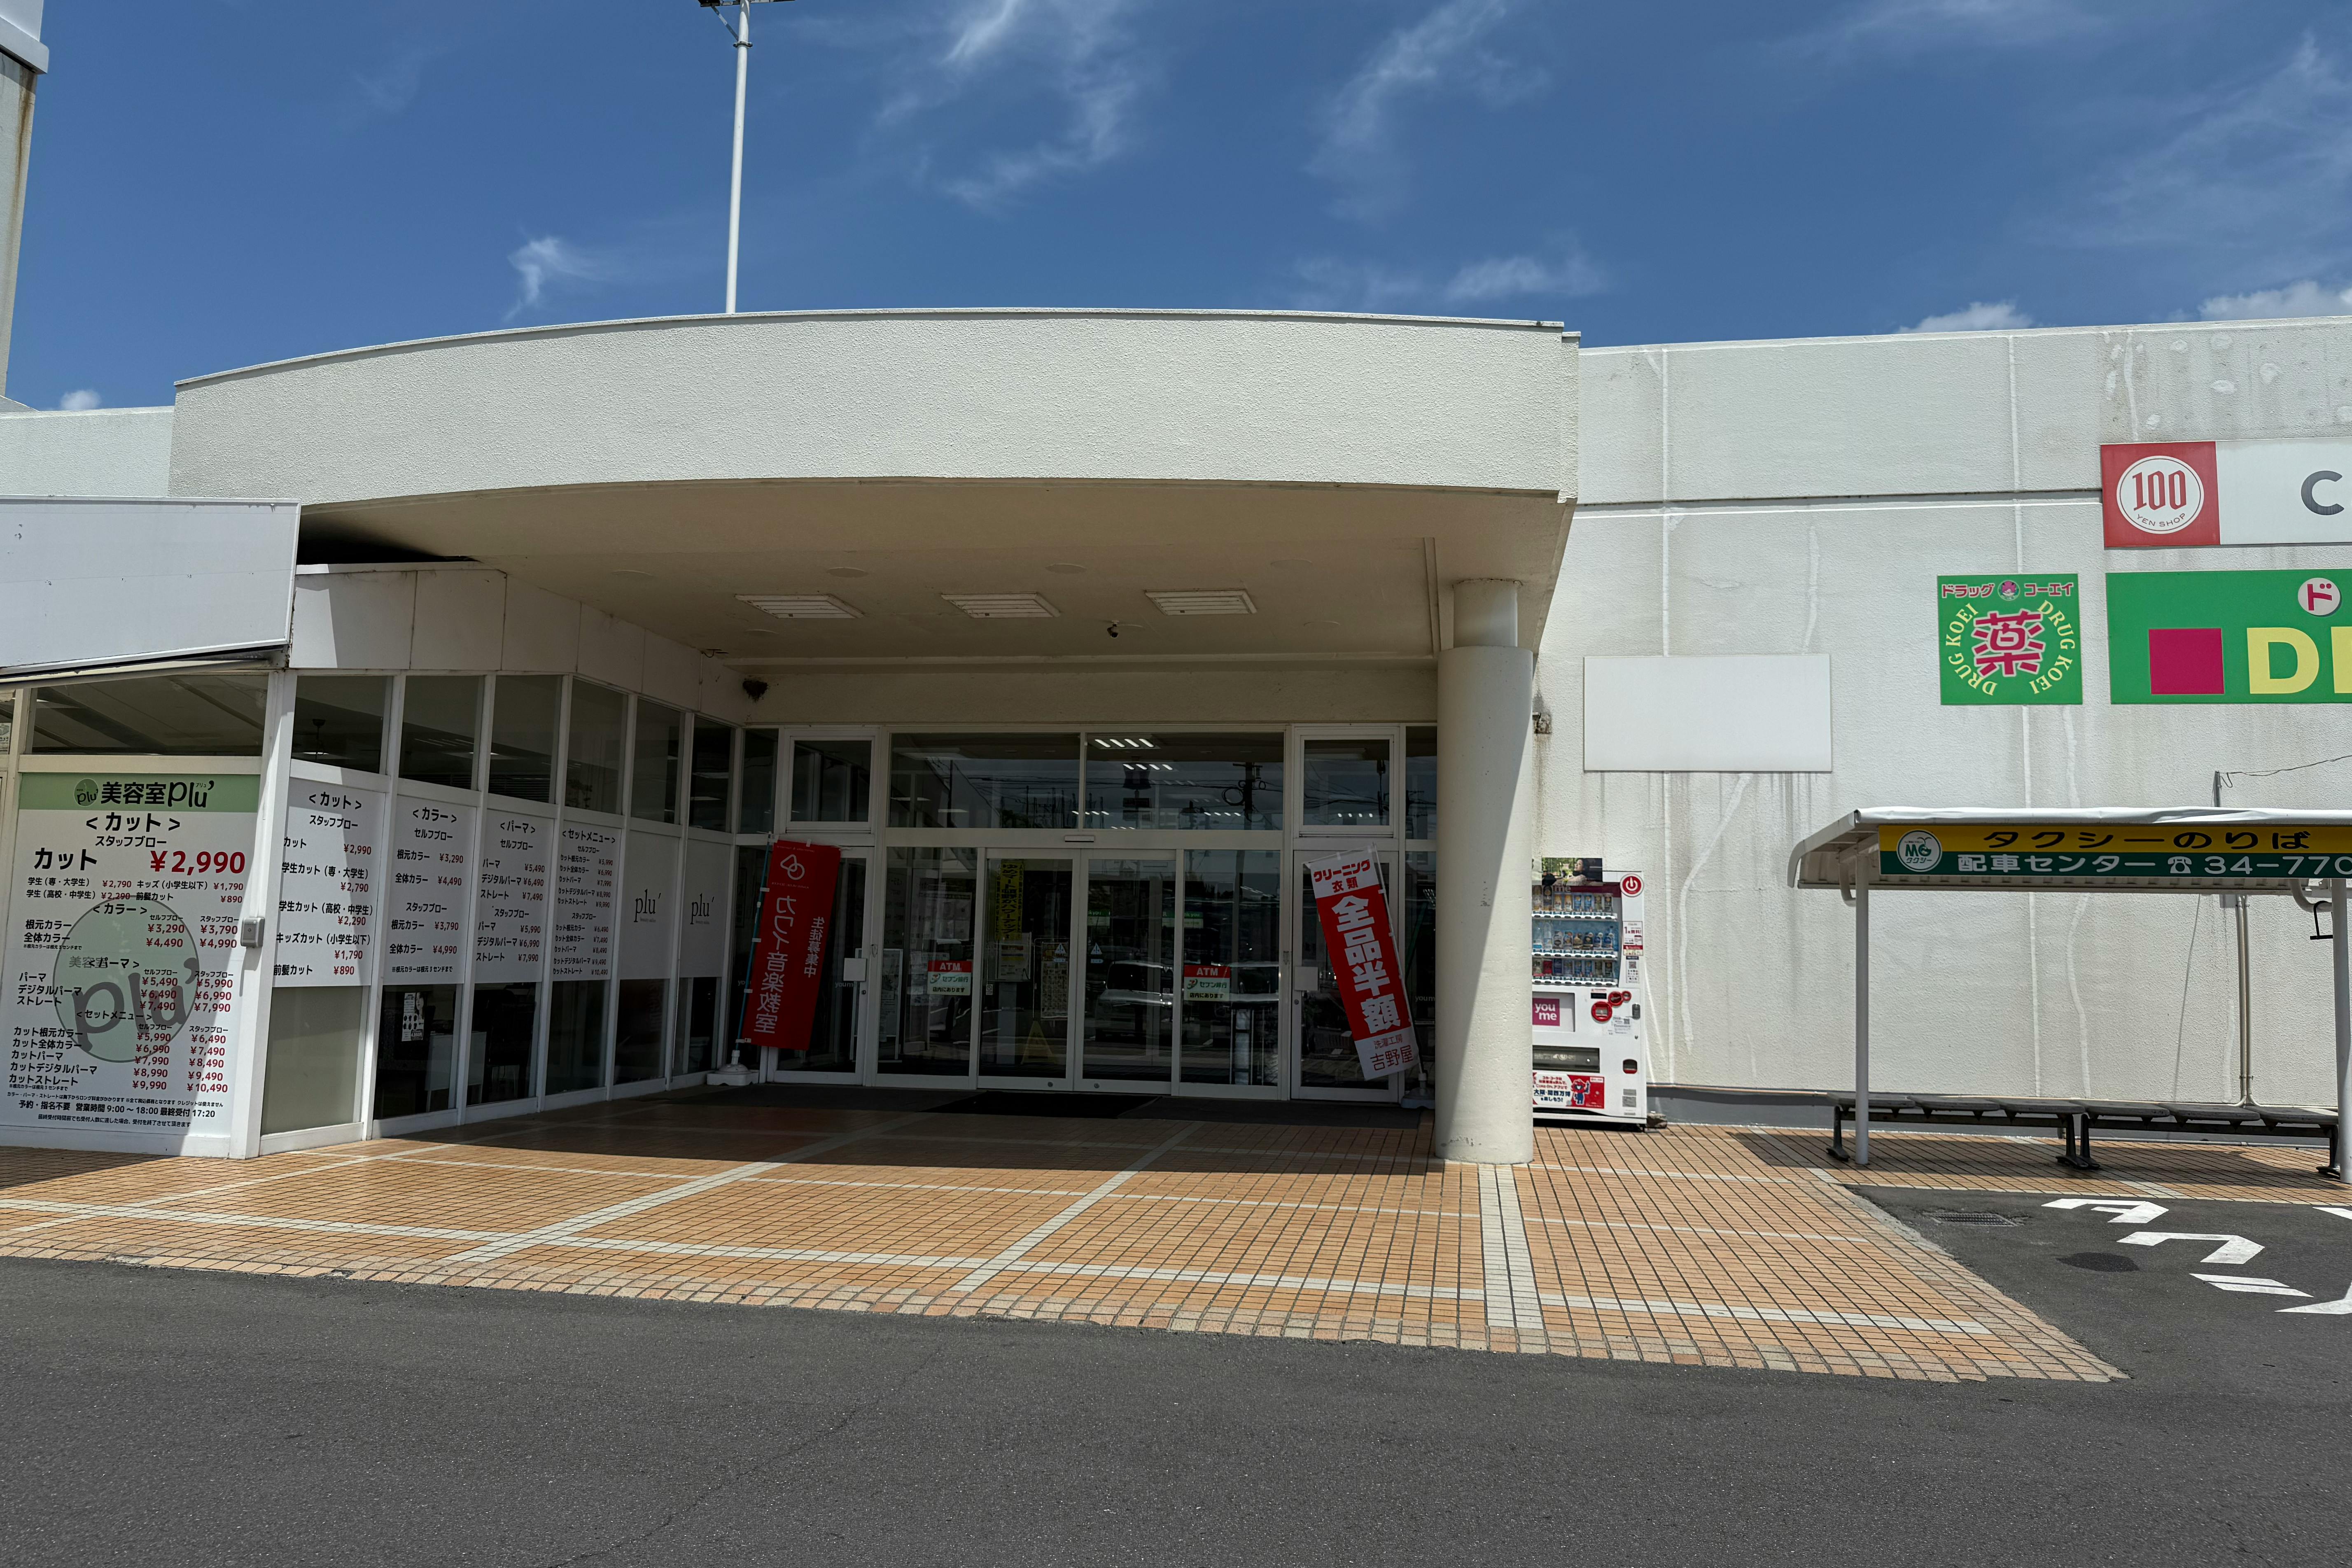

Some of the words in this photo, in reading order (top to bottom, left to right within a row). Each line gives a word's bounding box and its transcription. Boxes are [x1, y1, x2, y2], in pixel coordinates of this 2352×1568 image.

[2133, 470, 2186, 511] 100
[2137, 513, 2156, 527] YEN
[2159, 512, 2186, 527] SHOP
[1942, 583, 1995, 598] ドラッグ
[2025, 583, 2073, 596] コーエイ
[2307, 583, 2333, 611] ド
[1946, 603, 1979, 646] KOEI
[2038, 600, 2075, 650] DRUG
[2247, 627, 2352, 695] D
[1948, 653, 1997, 695] DRUG
[2029, 655, 2073, 694] KOEI
[100, 781, 166, 805] 美容室
[310, 815, 358, 829] スタッフブロー
[96, 835, 167, 848] スタッフブロー
[414, 828, 453, 841] セルフブロー
[1983, 830, 2311, 849] タクシーのりば
[283, 837, 306, 848] カット
[344, 844, 371, 855] ¥2,990
[500, 839, 533, 850] セルフブロー
[34, 848, 97, 870] カット
[150, 850, 245, 875] ¥2,990
[397, 849, 430, 860] 根元カラー
[440, 853, 463, 863] ¥3,290
[1957, 854, 2156, 873] 配車センター
[483, 859, 500, 869] パーマ
[525, 864, 545, 873] ¥5,490
[1313, 859, 1371, 882] クリーニング
[28, 877, 90, 887] 学生(専・大学生)
[102, 880, 131, 888] ¥2,790
[137, 880, 208, 890] キッズ(小学生以下)
[213, 882, 243, 891] ¥1,790
[341, 882, 369, 892] ¥2,790
[395, 873, 428, 884] 全体カラー
[438, 875, 462, 886] ¥4,490
[481, 874, 522, 886] デジタルパーマ
[523, 877, 544, 887] ¥6,490
[1332, 877, 1358, 893] 衣類
[26, 889, 96, 899] 学生(高校・中学生)
[101, 892, 131, 900] ¥2,290
[136, 891, 174, 901] 前髪カット
[481, 889, 509, 900] ストレート
[523, 892, 543, 901] ¥7,490
[406, 903, 447, 913] スタッフブロー
[494, 909, 530, 918] スタッフブロー
[26, 919, 72, 930] 根元カラー
[148, 924, 184, 934] ¥3,290
[201, 925, 238, 935] ¥3,790
[338, 916, 366, 926] ¥2,290
[391, 919, 424, 930] 根元カラー
[434, 921, 459, 931] ¥3,790
[478, 922, 496, 931] パーマ
[520, 925, 541, 933] ¥5,990
[24, 932, 70, 943] 全体カラー
[146, 938, 183, 948] ¥4,490
[200, 938, 237, 948] ¥4,990
[477, 937, 518, 947] デジタルパーマ
[519, 939, 540, 947] ¥6,990
[335, 950, 363, 960] ¥1,790
[390, 944, 422, 954] 全体カラー
[433, 945, 457, 954] ¥4,990
[476, 952, 505, 962] ストレート
[518, 954, 539, 962] ¥7,990
[1332, 895, 1401, 1034] 全品半額
[334, 966, 355, 975] ¥890
[939, 963, 961, 971] ATM
[1196, 967, 1218, 976] ATM
[19, 973, 46, 982] パーマ
[142, 977, 178, 987] ¥5,490
[197, 978, 233, 988] ¥5,990
[18, 984, 82, 996] デジタルパーマ
[141, 990, 177, 999] ¥6,490
[195, 991, 231, 1001] ¥6,990
[16, 996, 62, 1006] ストレート
[140, 1001, 175, 1011] ¥7,490
[194, 1002, 231, 1013] ¥7,990
[1534, 1003, 1556, 1014] you
[1539, 1012, 1557, 1021] me
[14, 1027, 83, 1038] カット根元カラー
[137, 1032, 171, 1043] ¥5,990
[191, 1034, 226, 1044] ¥6,490
[189, 1025, 228, 1034] スタッフブロー
[12, 1038, 82, 1050] カット全体カラー
[136, 1044, 170, 1054] ¥6,990
[190, 1046, 225, 1057] ¥7,490
[11, 1050, 63, 1061] カットパーマ
[135, 1056, 169, 1066] ¥7,990
[189, 1058, 224, 1068] ¥8,490
[10, 1062, 97, 1074] カットデジタルパーマ
[133, 1068, 168, 1078] ¥8,990
[188, 1071, 223, 1081] ¥9,490
[9, 1074, 78, 1086] カットストレート
[132, 1080, 167, 1090] ¥9,990
[187, 1083, 228, 1093] ¥10,490
[19, 1100, 71, 1111] 予約・指名不要
[76, 1103, 105, 1113] 営業時間
[107, 1104, 125, 1113] 9:00
[136, 1106, 159, 1115] 18:00
[192, 1109, 215, 1118] 17:20
